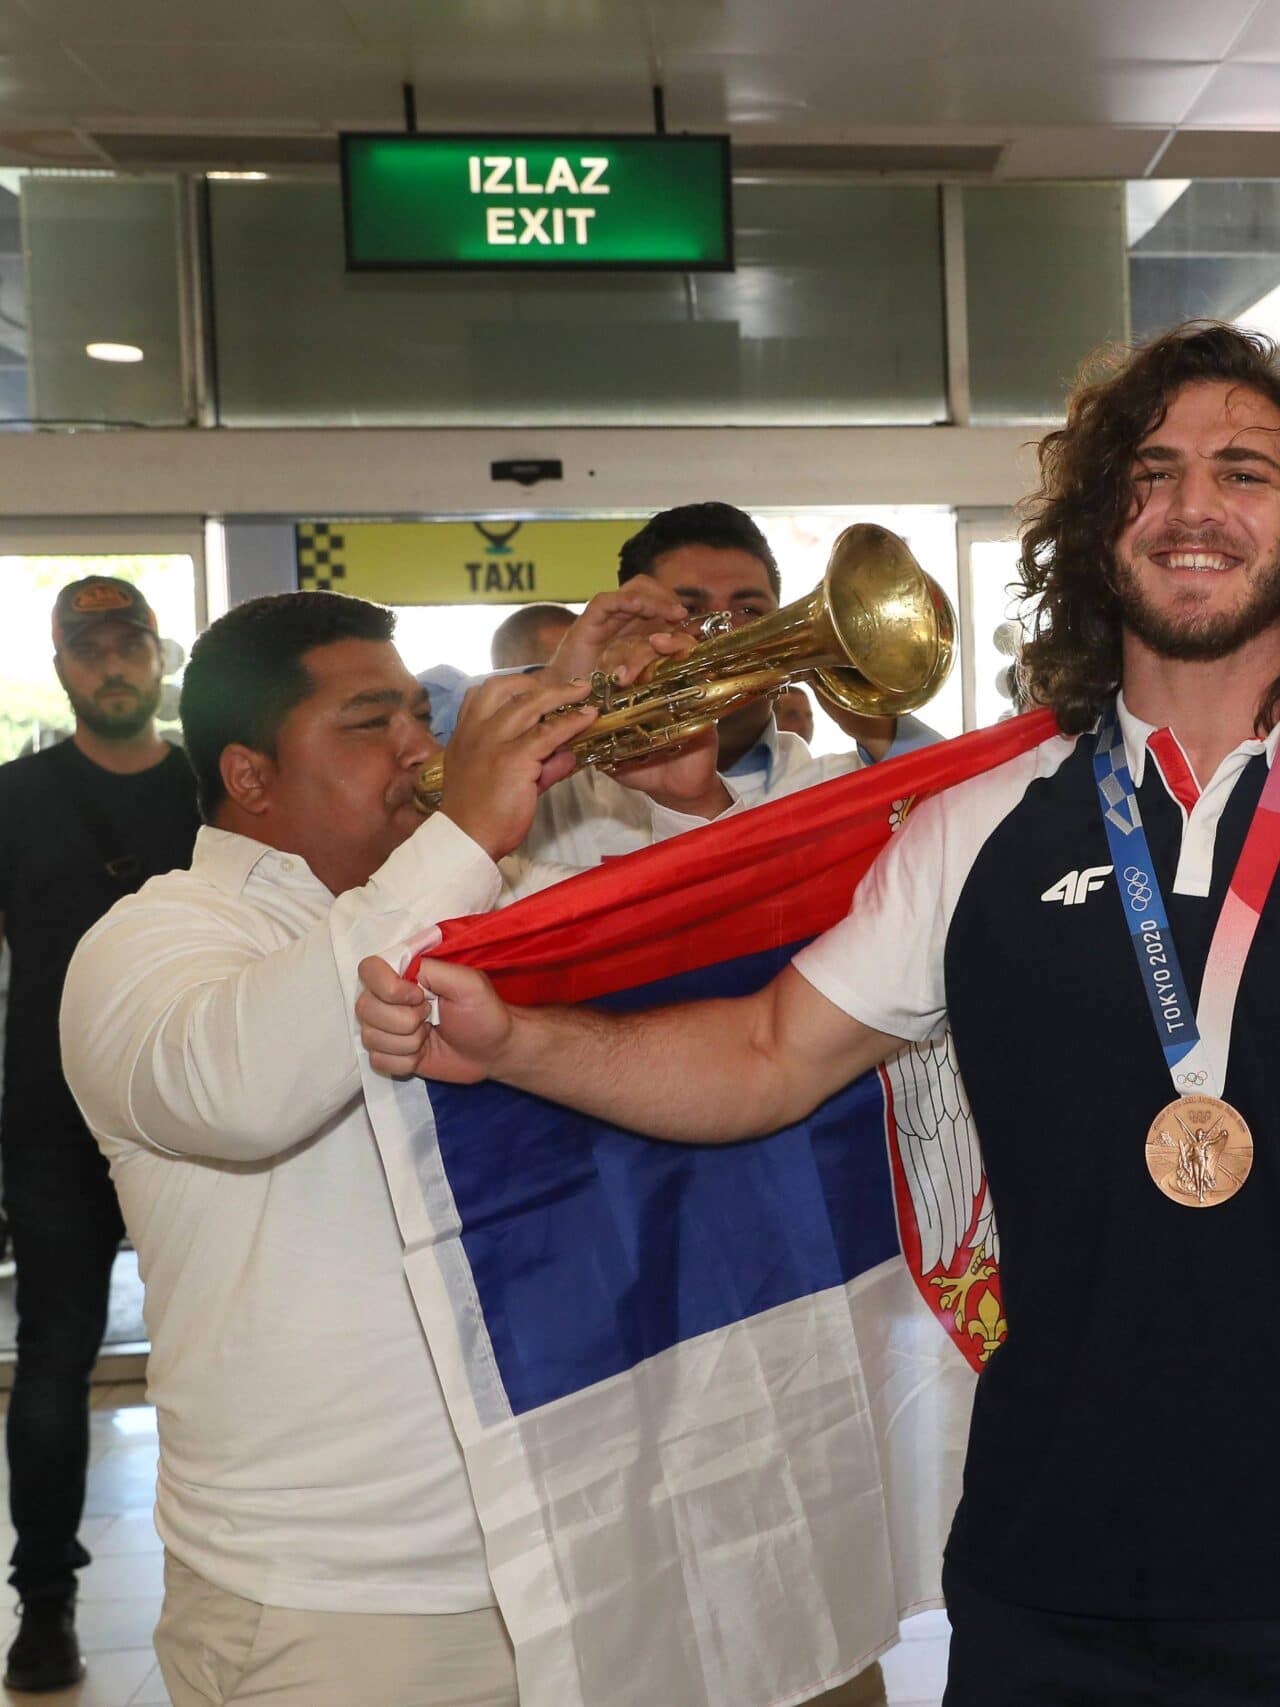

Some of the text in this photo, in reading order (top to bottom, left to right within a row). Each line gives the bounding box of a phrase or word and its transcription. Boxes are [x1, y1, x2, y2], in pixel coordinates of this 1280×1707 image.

[468, 156, 610, 194] IZLAZ
[486, 207, 596, 245] EXIT
[464, 562, 535, 592] TAXI
[1040, 865, 1115, 906] 4F
[1140, 919, 1185, 1033] TOKYO 2020
